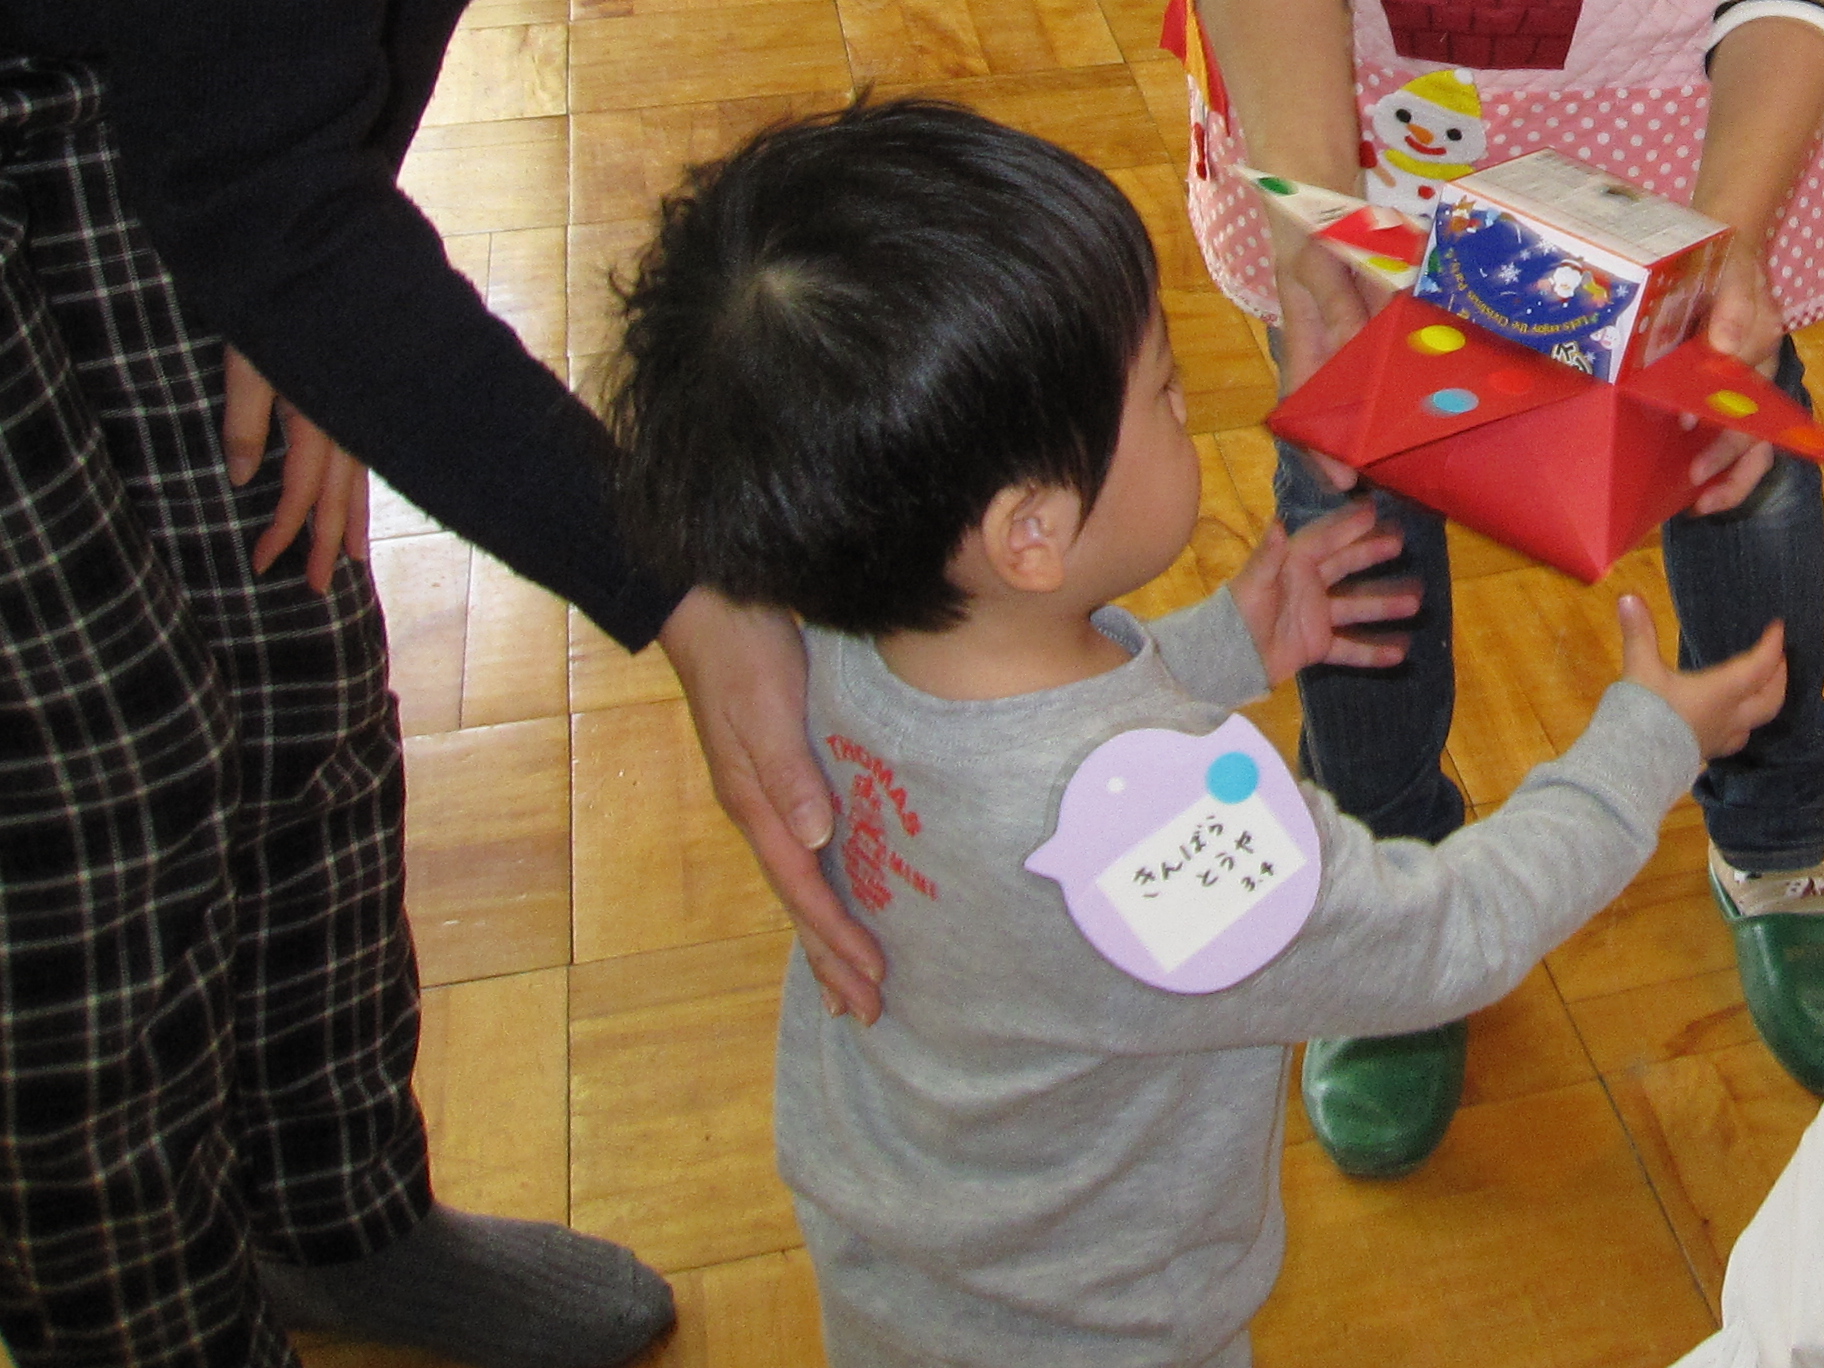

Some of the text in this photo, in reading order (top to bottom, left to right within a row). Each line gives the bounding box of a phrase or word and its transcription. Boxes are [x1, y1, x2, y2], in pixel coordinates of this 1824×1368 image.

[1467, 290, 1509, 327] Christmas
[1511, 320, 1529, 334] the
[1532, 323, 1560, 334] enjoy
